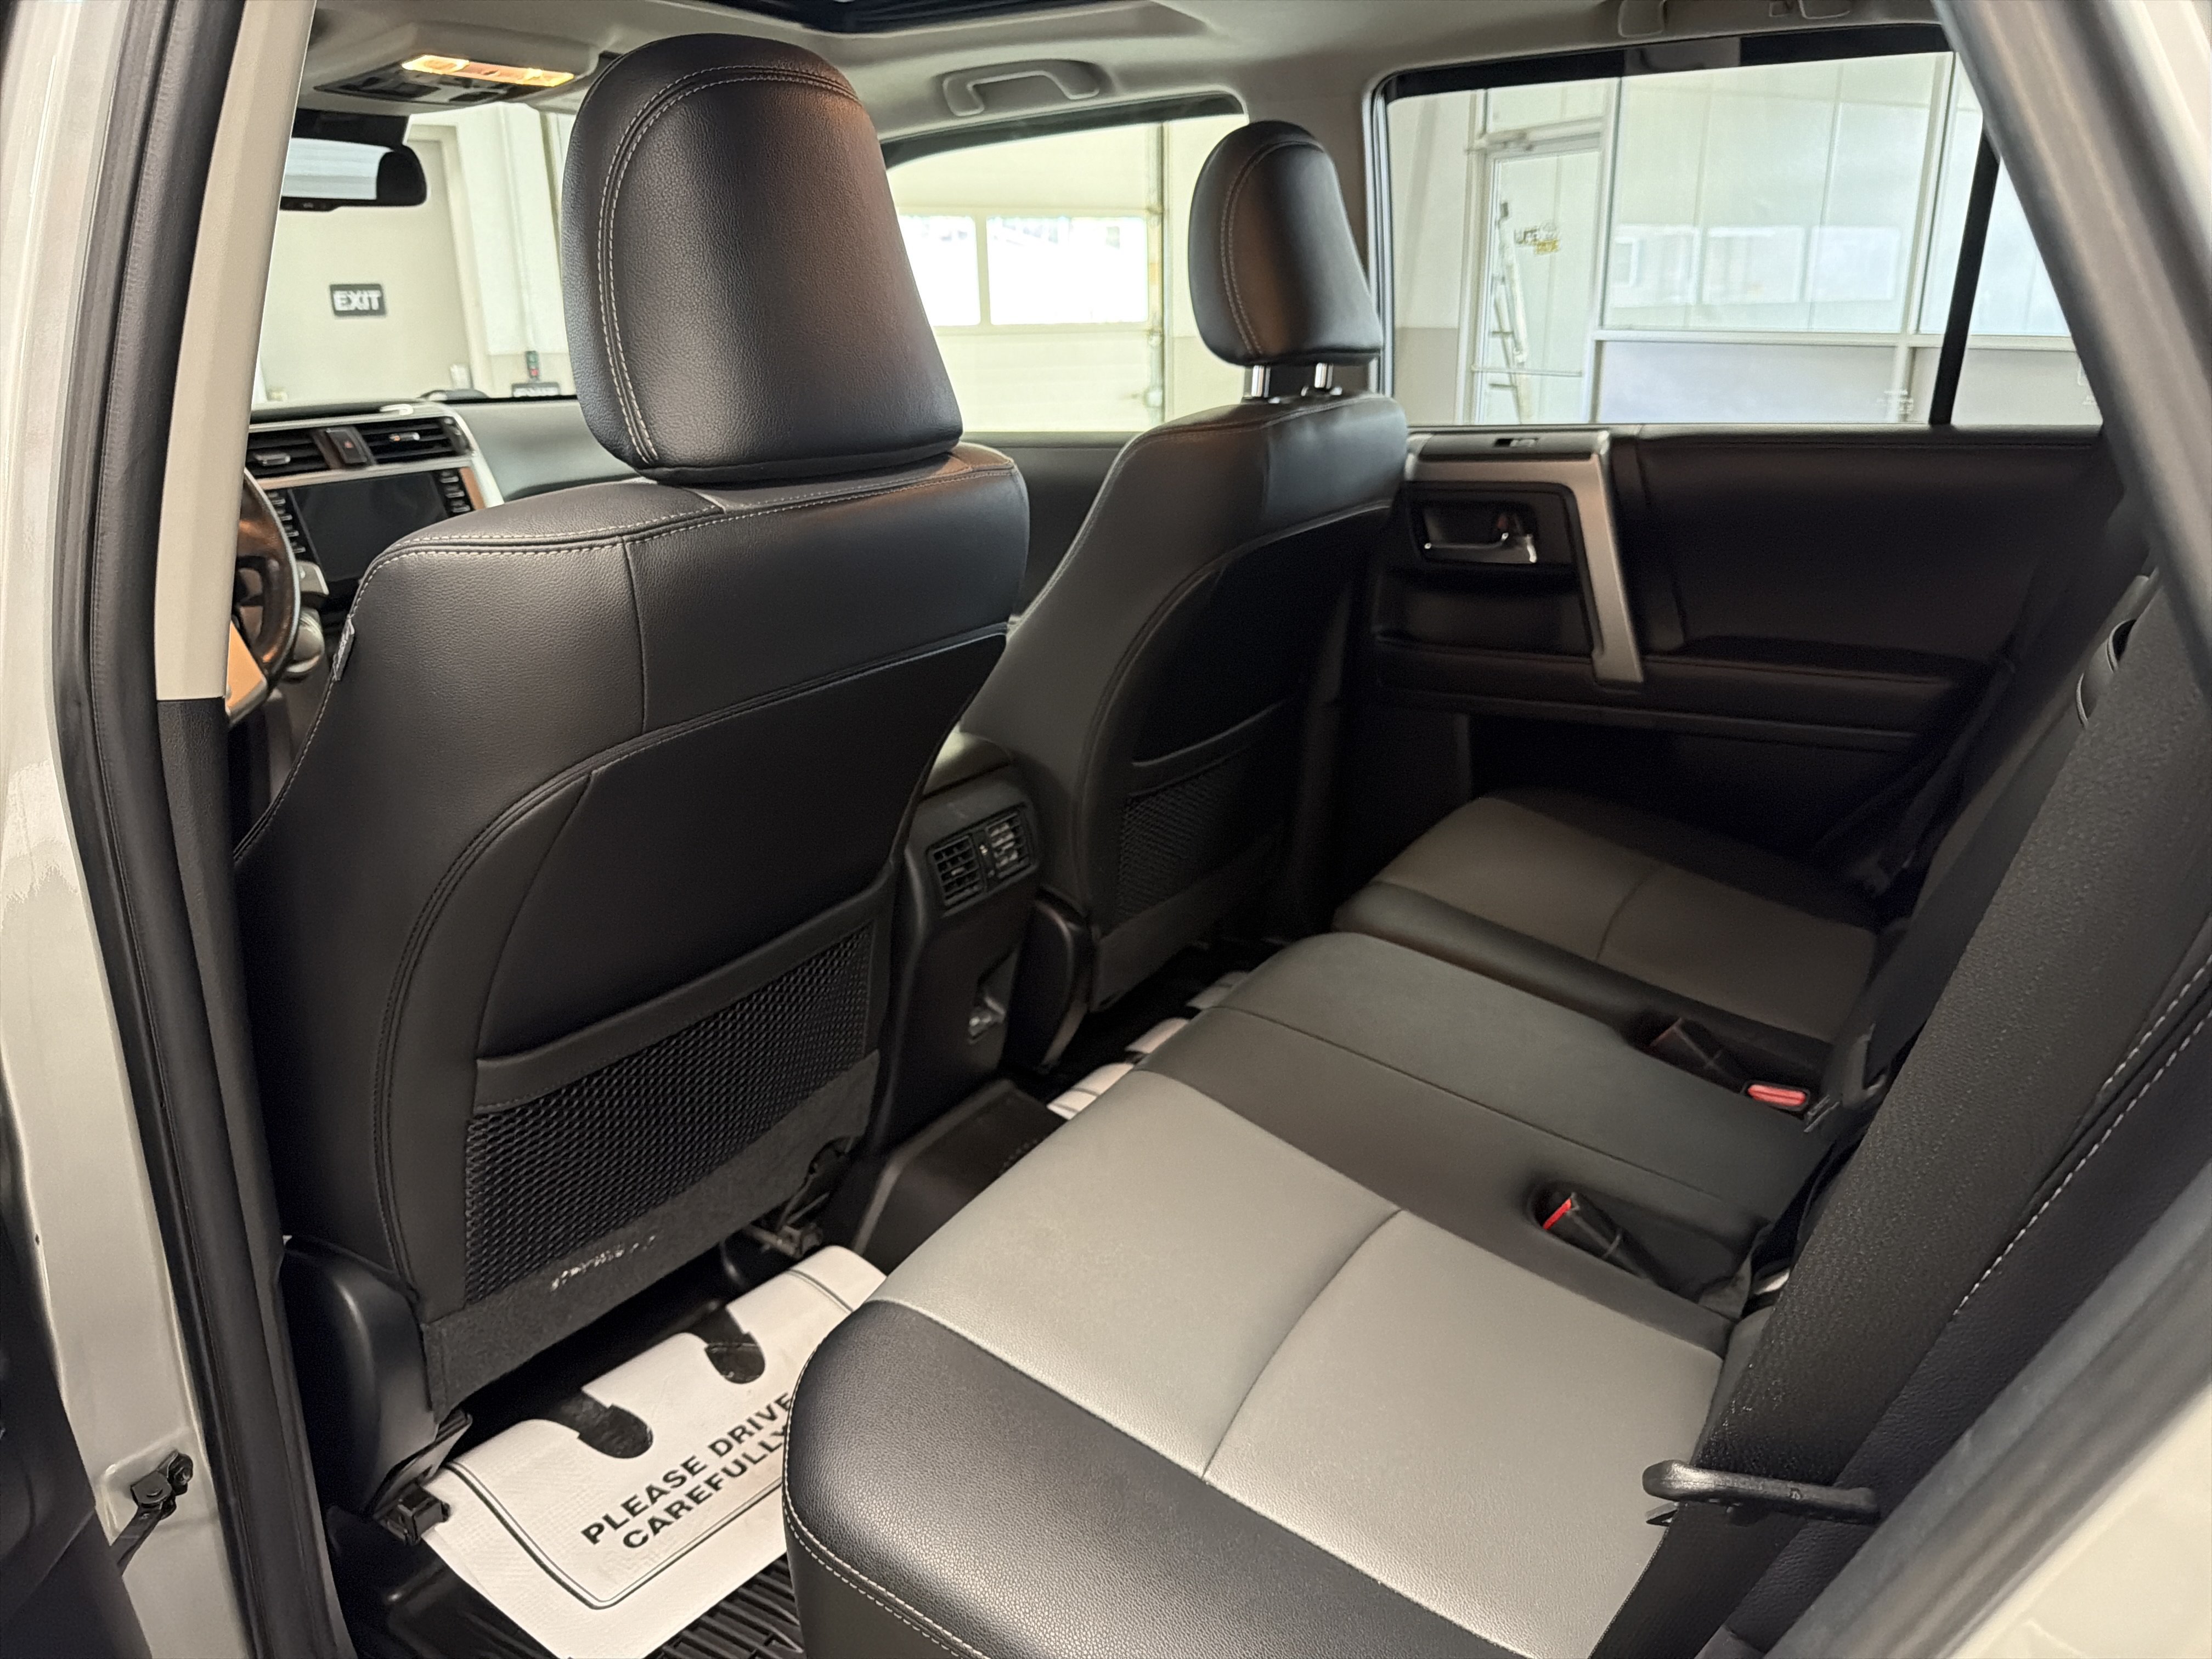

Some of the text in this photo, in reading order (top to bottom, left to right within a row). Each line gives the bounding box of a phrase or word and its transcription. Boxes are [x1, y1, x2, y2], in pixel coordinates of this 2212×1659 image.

[333, 290, 382, 311] EXIT
[581, 1391, 790, 1545] PLEASE DRIVE
